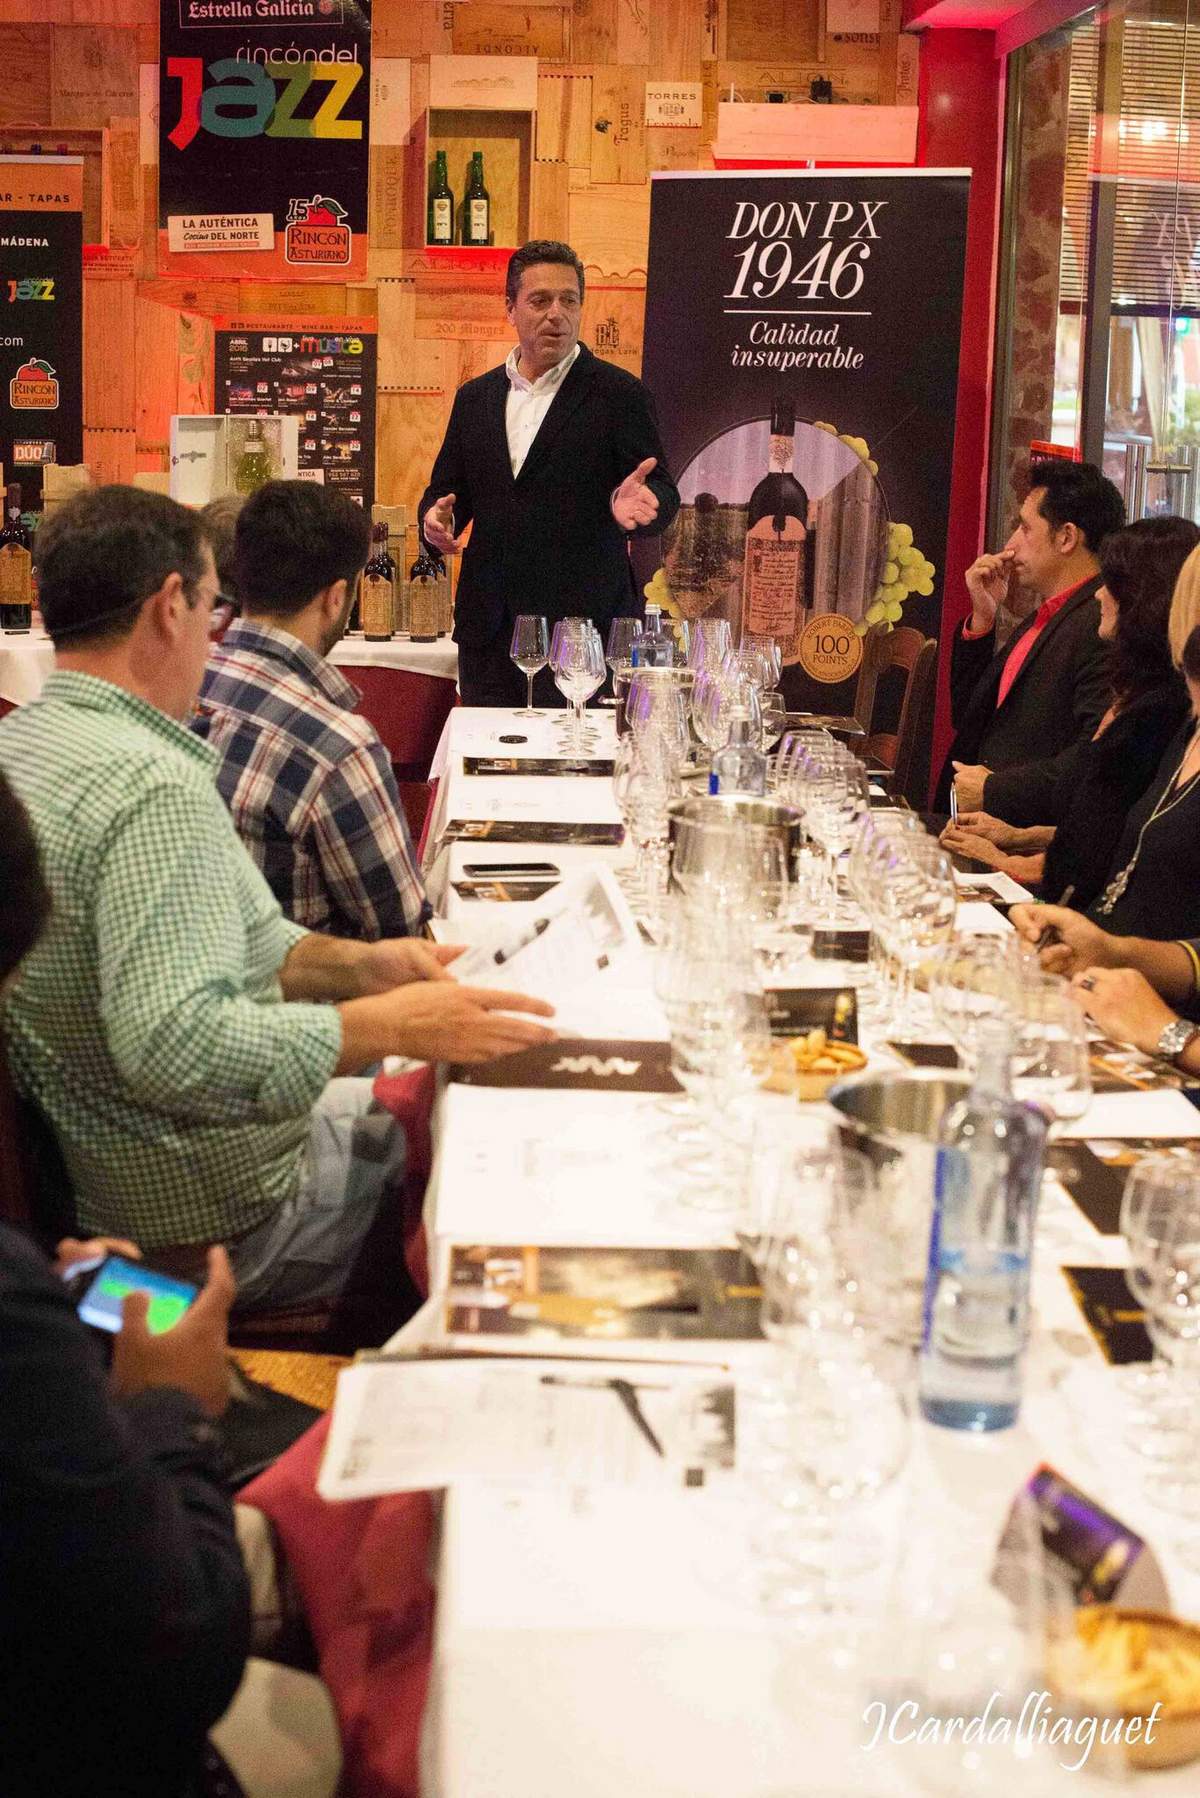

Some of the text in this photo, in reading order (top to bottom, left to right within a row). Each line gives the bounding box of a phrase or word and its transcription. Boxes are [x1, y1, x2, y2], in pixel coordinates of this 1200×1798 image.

[188, 0, 314, 18] Estrella Galicia
[647, 92, 697, 100] TORRES
[28, 193, 70, 203] TAPAS
[289, 199, 308, 216] 15
[182, 216, 259, 229] LA AUTÉNTICA
[725, 201, 820, 239] DON
[0, 235, 50, 247] MÁDENA
[183, 231, 260, 241] Cocina DEL NORTE
[291, 227, 347, 246] RINCÓN
[290, 248, 347, 261] ASTURIANO
[723, 240, 871, 300] 1946
[749, 320, 840, 346] Calidad
[731, 345, 865, 372] insuperable
[14, 382, 56, 395] RINCÓN
[815, 634, 850, 655] 100
[812, 654, 849, 665] POINTS
